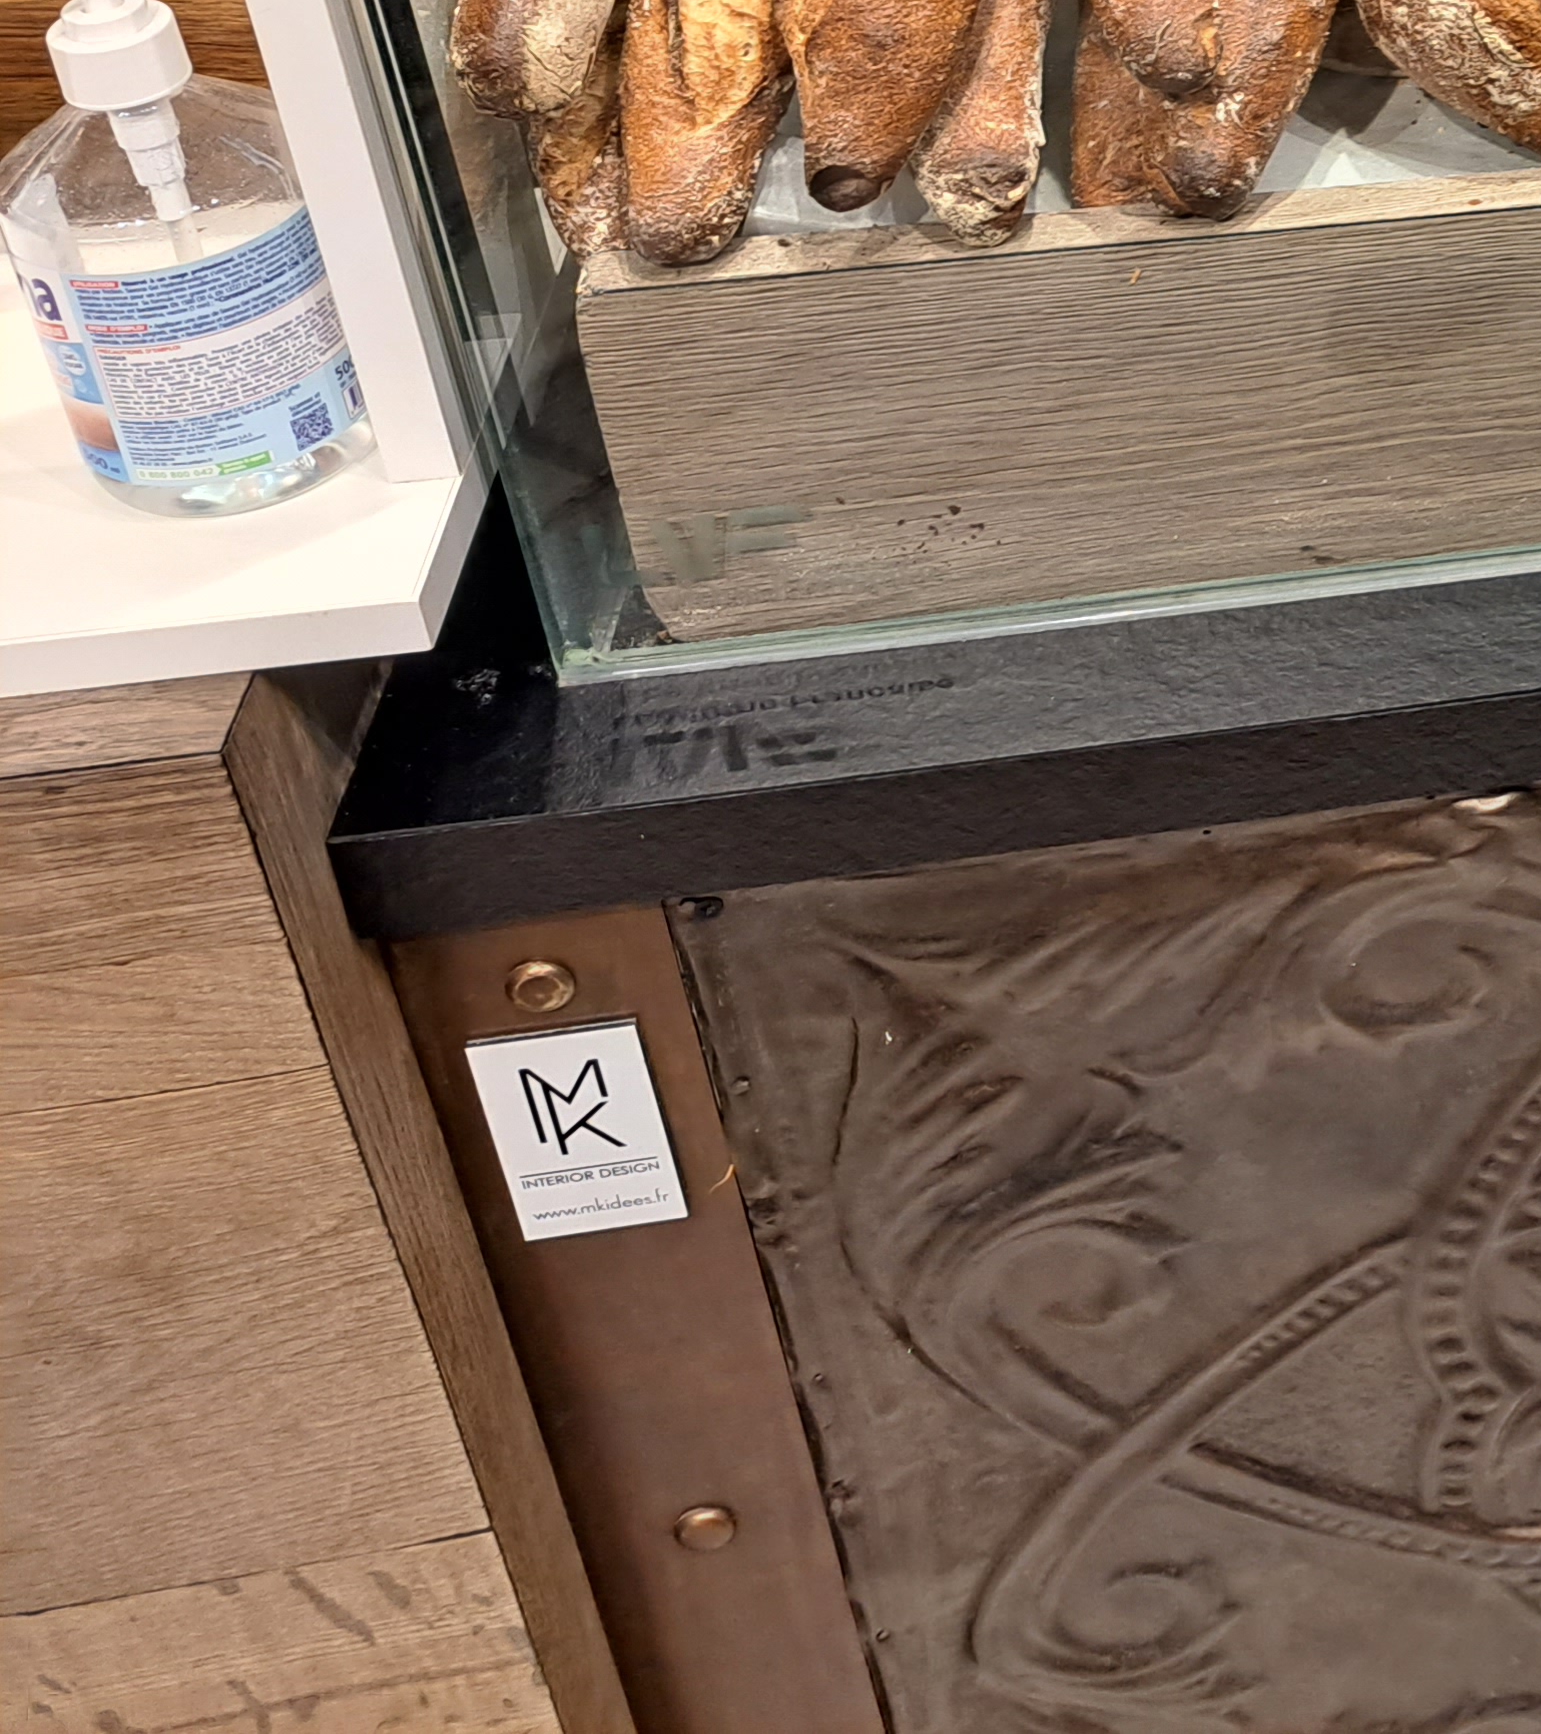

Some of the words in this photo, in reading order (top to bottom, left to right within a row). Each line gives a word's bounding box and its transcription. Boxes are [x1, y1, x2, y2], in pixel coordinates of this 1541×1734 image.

[521, 1170, 595, 1190] INTERIOR
[599, 1160, 661, 1179] DESIGN
[532, 1187, 670, 1221] www.mkidees.fr
